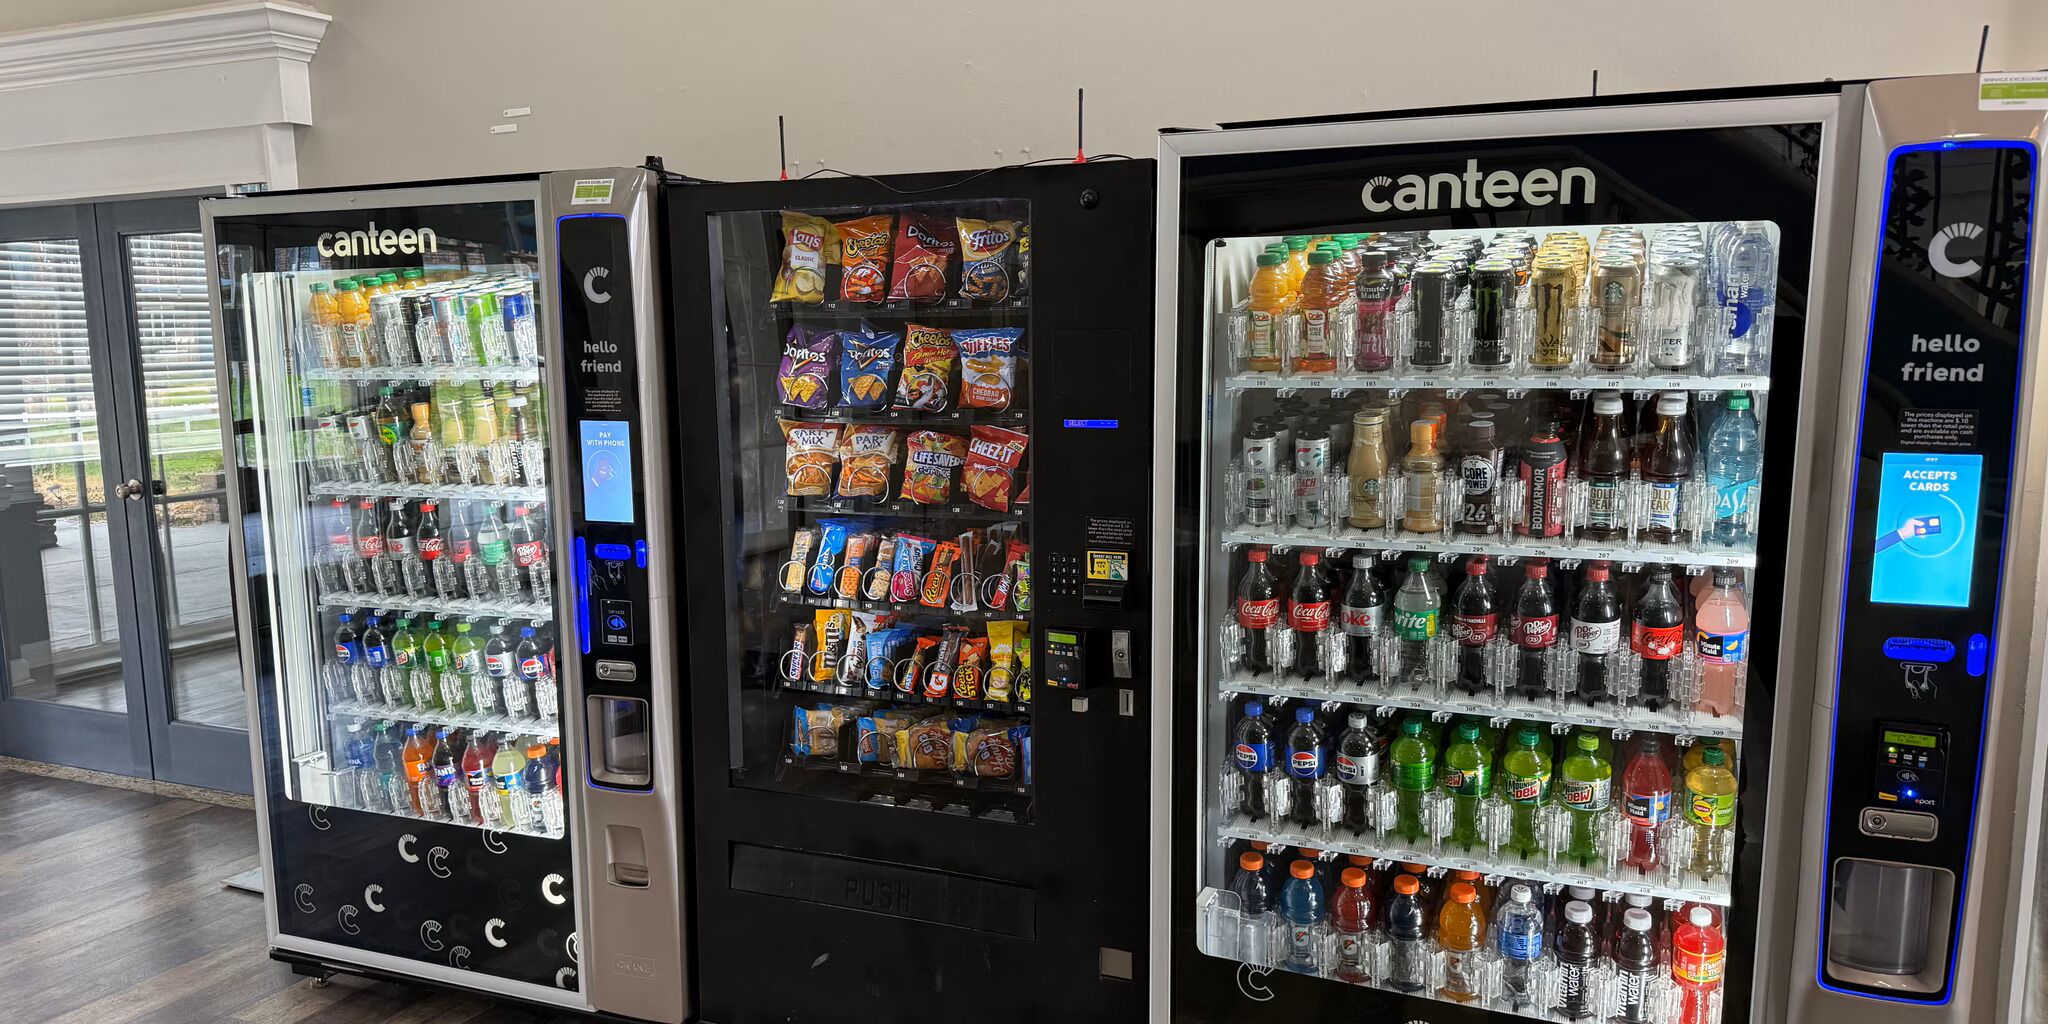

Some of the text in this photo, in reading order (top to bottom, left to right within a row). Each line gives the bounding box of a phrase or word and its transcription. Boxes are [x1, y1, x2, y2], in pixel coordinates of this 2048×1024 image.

[1361, 158, 1596, 213] canteen
[317, 221, 437, 257] canteen
[793, 229, 822, 248] Lay's
[907, 225, 956, 248] Doritos
[969, 229, 1010, 251] Fritos
[846, 232, 889, 257] Cheetos
[794, 255, 815, 263] CLASSIC
[1740, 271, 1750, 299] water
[1254, 313, 1270, 321] Dole
[910, 330, 952, 349] Cheetos
[1911, 334, 1981, 353] hello
[583, 341, 618, 353] hello
[783, 342, 826, 363] Doritos
[849, 347, 891, 361] Doritos
[580, 360, 622, 373] friend
[1901, 362, 1985, 382] friend
[972, 387, 999, 398] CHEDDAR
[794, 429, 833, 439] PARTY
[968, 437, 1015, 464] CHEEZ-IT
[1464, 468, 1487, 479] CORE
[1903, 470, 1958, 480] ACCEPTS
[1465, 479, 1488, 490] POWER
[1909, 482, 1949, 492] CARDS
[1532, 468, 1545, 531] BODYARMOR
[1590, 489, 1614, 500] GOLD
[1653, 489, 1671, 500] OLD
[1589, 499, 1613, 511] PEAK
[1651, 500, 1670, 511] EAK
[1465, 503, 1487, 521] 26
[1241, 600, 1280, 617] Coca-Cola
[1292, 602, 1331, 620] Coca-Cola
[1525, 623, 1551, 635] Pepper
[1576, 627, 1600, 639] Pepper
[1641, 629, 1682, 645] Coca-Cola
[1701, 641, 1721, 650] Minute
[1702, 647, 1718, 655] Maid
[919, 733, 933, 754] BIG
[978, 740, 991, 760] BIG
[1236, 752, 1256, 761] PEPSI
[1292, 759, 1316, 767] PEPSI
[1337, 763, 1356, 773] PEPSI
[1515, 786, 1538, 799] DEW
[1567, 789, 1590, 802] DEW
[1915, 798, 1936, 806] eport
[846, 879, 912, 914] PUSH
[1558, 961, 1570, 1009] vitamin
[1617, 969, 1629, 1017] vitamin
